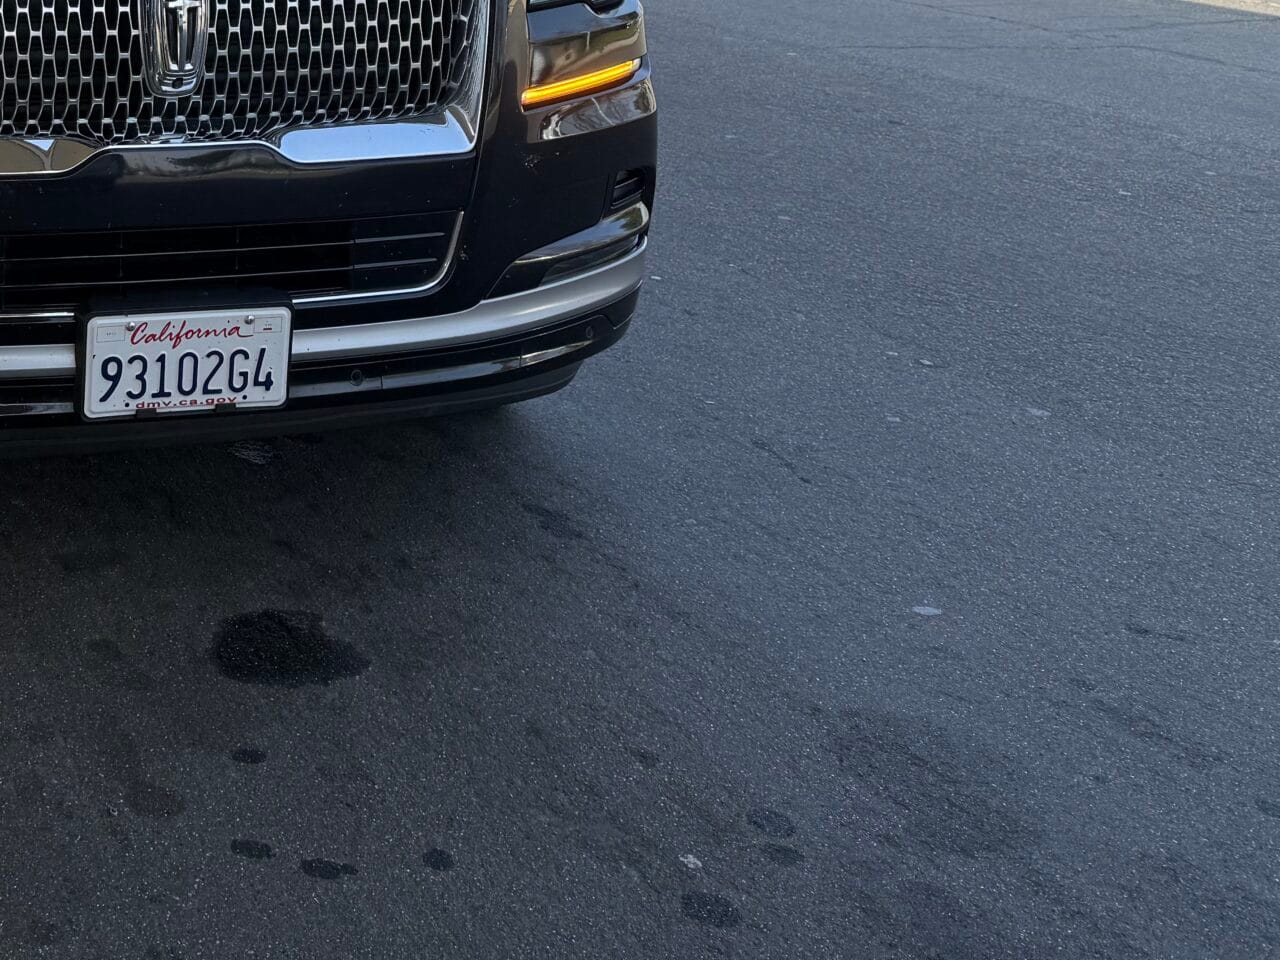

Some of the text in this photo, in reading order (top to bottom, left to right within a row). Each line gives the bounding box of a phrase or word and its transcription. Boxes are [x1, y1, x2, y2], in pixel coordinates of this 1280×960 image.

[130, 320, 254, 349] California
[99, 347, 274, 403] 93102G4
[135, 396, 238, 409] dmv.ca.gov
